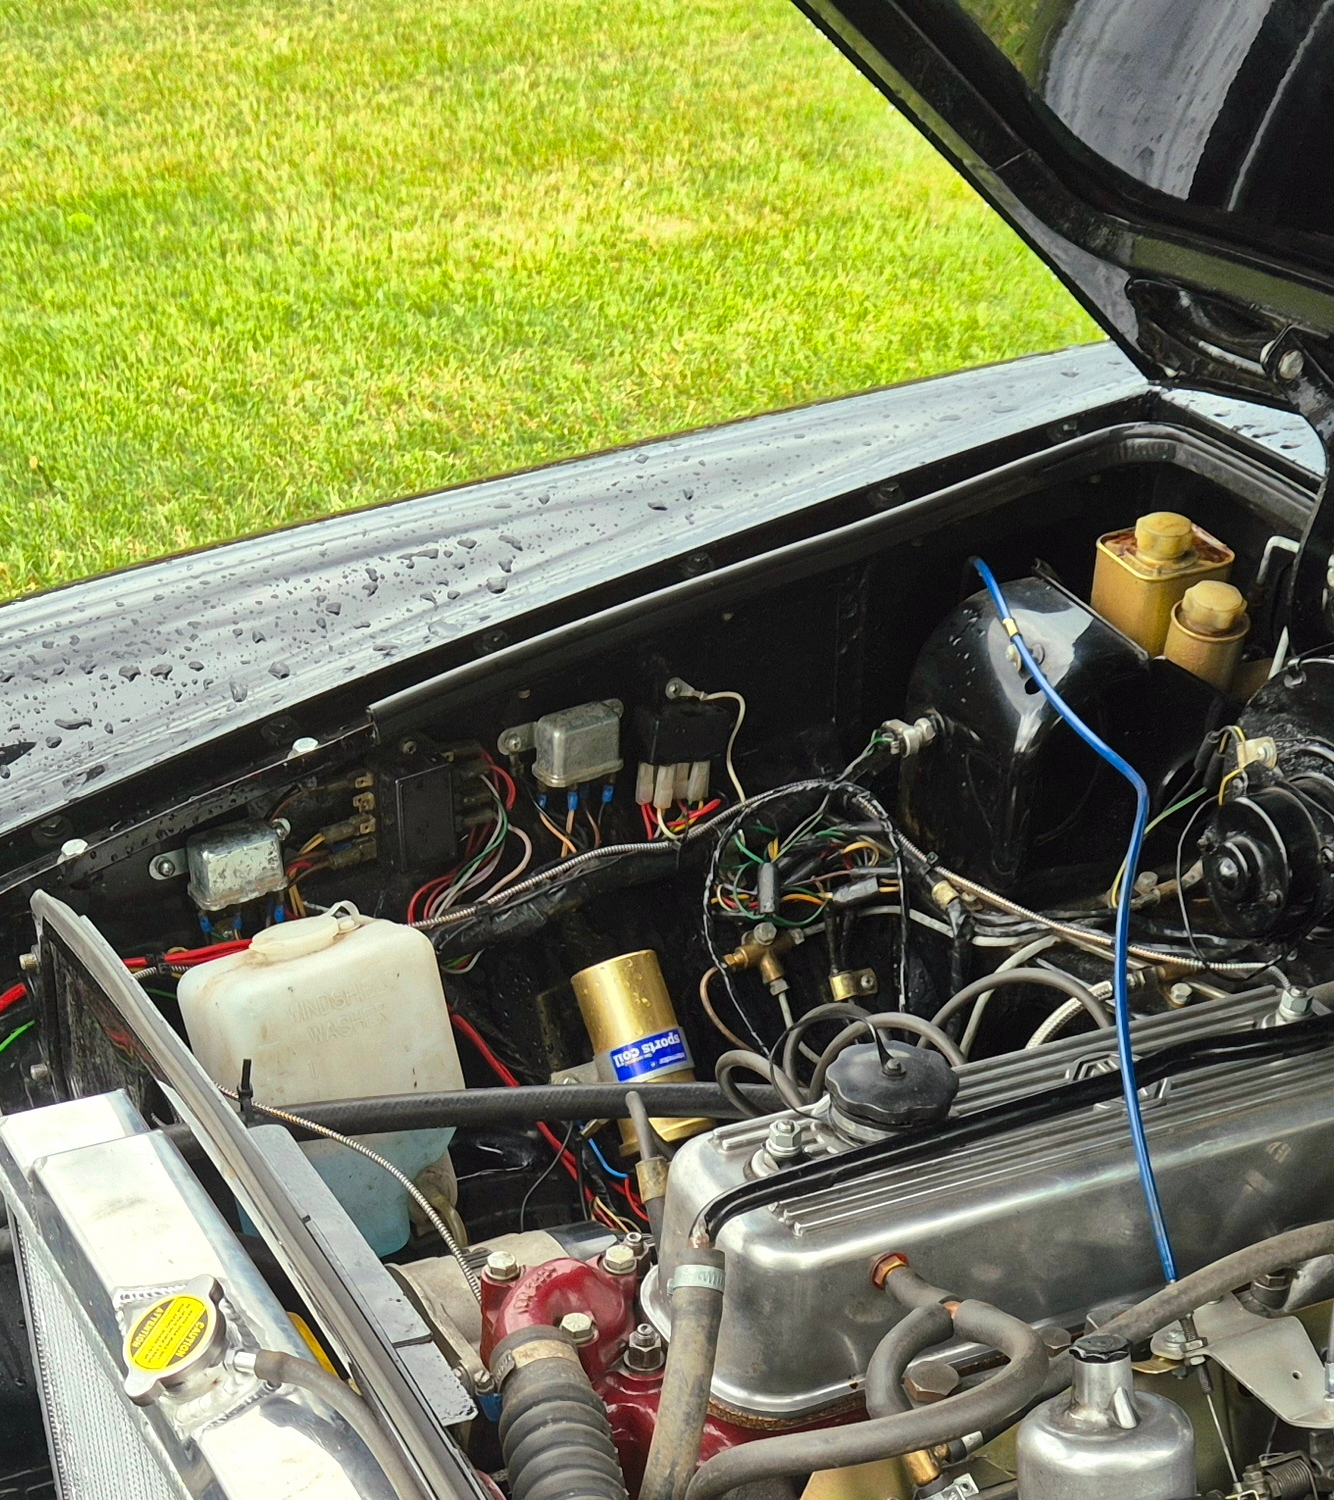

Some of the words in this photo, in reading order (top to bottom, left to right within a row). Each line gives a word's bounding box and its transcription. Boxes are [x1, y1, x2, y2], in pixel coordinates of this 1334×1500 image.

[307, 1003, 388, 1045] WASHER
[613, 1048, 640, 1068] coil
[641, 1032, 680, 1055] sports
[131, 1307, 164, 1349] ATTENTION
[175, 1321, 205, 1358] CAUTION
